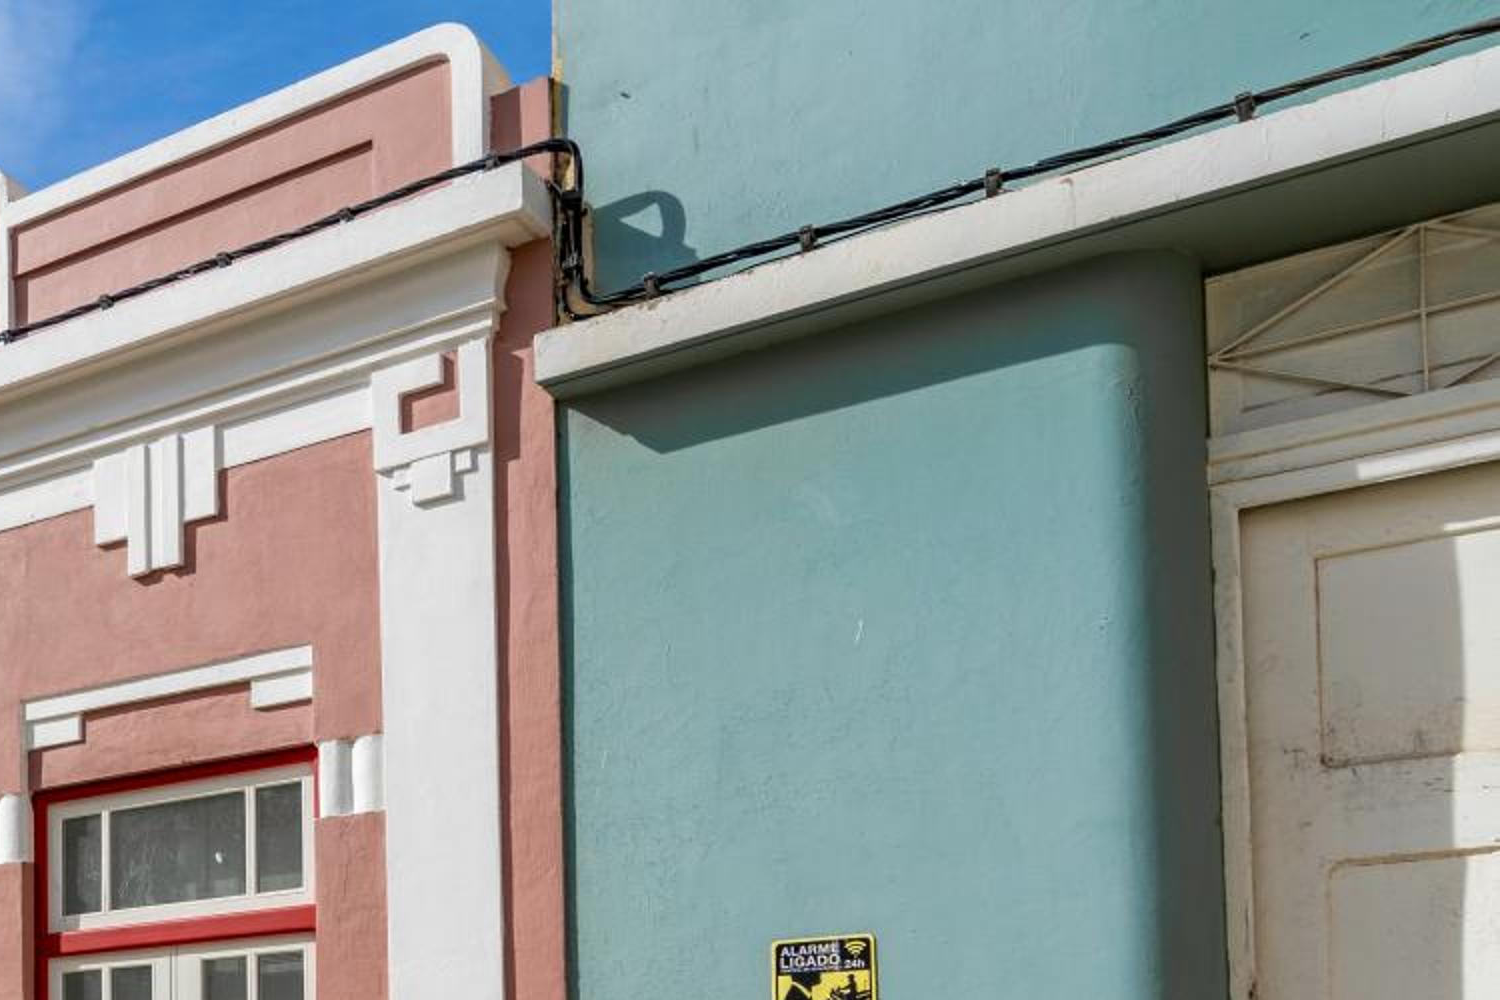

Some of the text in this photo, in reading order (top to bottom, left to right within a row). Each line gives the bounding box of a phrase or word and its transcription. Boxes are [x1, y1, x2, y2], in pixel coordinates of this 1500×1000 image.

[781, 941, 840, 957] ALARME
[780, 954, 841, 969] LIGADO
[844, 959, 865, 969] 24h
